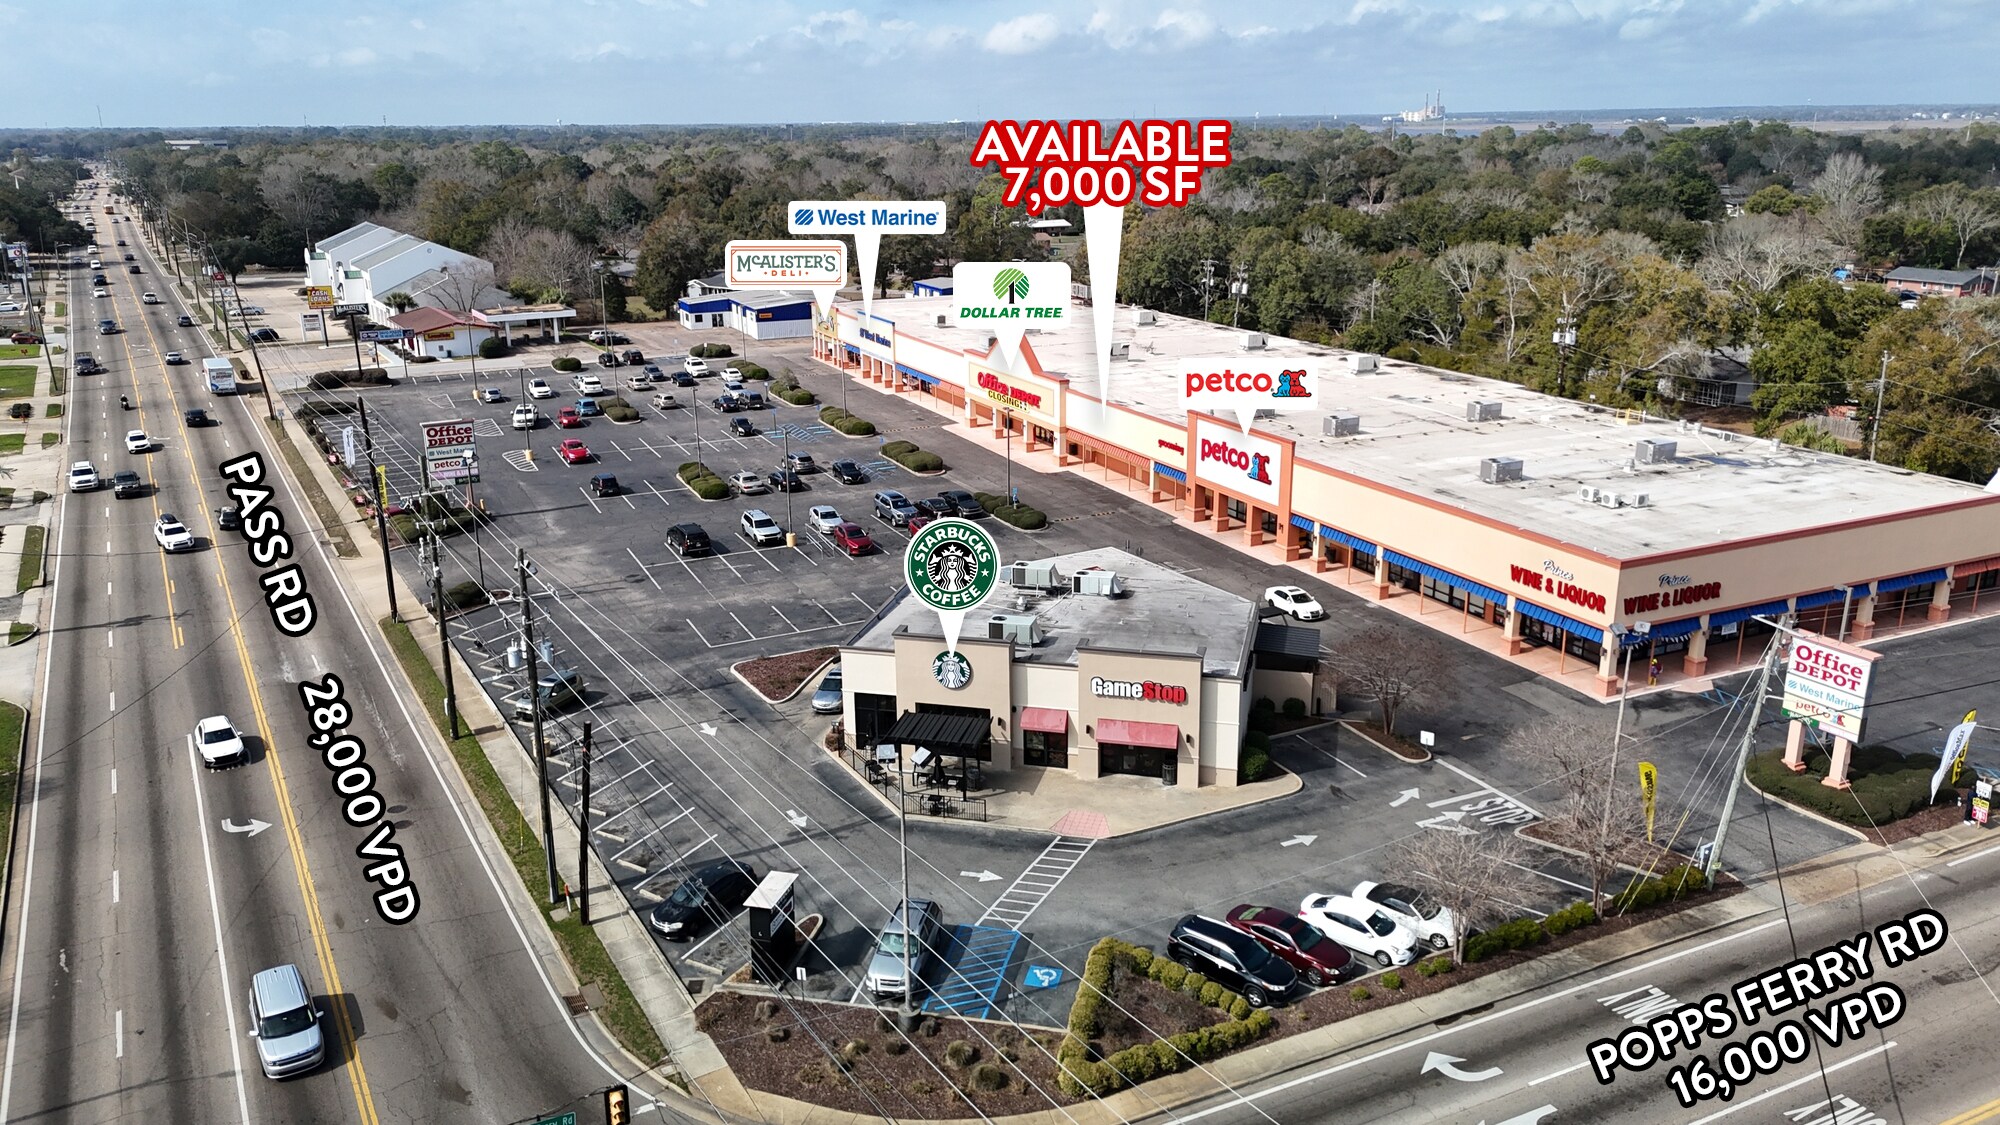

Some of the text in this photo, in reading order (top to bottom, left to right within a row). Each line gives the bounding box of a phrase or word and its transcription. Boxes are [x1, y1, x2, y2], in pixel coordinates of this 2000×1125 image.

[977, 371, 1041, 409] Office DEPOT
[426, 425, 473, 438] Office
[427, 435, 473, 447] DEPOT
[433, 460, 461, 470] petco
[1201, 438, 1250, 471] petco
[1510, 563, 1607, 615] WINE & LIQUOR
[1623, 581, 1721, 616] WINE & LIQUOR
[1793, 660, 1861, 692] DEPOT
[1795, 644, 1863, 679] Office
[1090, 676, 1187, 704] GameStop
[1799, 683, 1861, 711] West Marine
[1459, 797, 1534, 826] STOP
